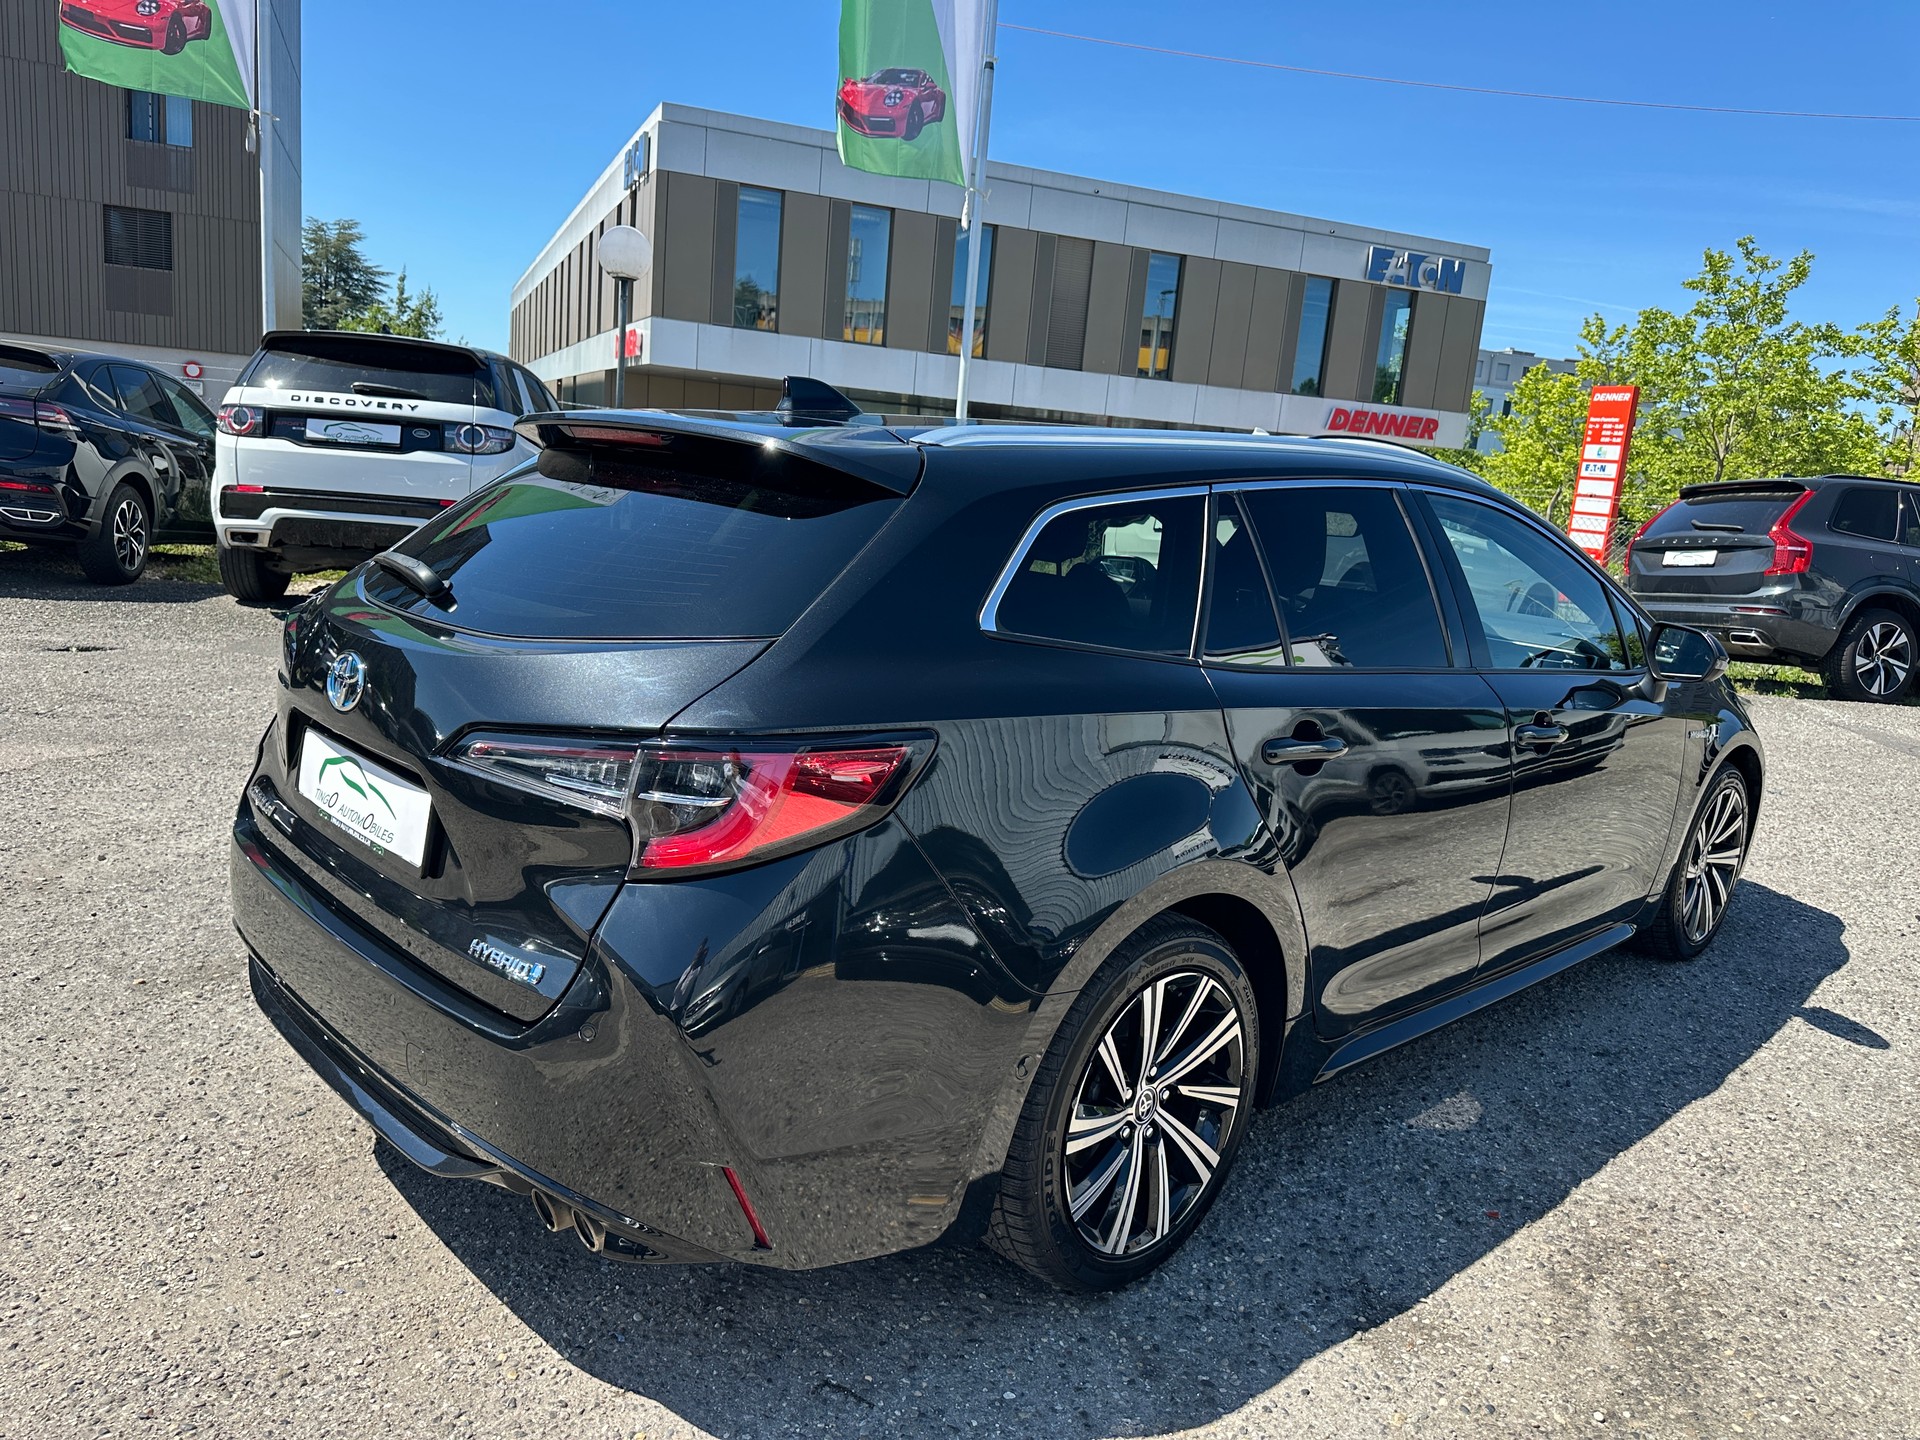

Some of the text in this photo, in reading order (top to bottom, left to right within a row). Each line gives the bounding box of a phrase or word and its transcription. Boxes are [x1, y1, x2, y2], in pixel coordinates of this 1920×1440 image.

[1366, 246, 1466, 295] EATON
[291, 394, 419, 411] DISCOVERY
[1593, 393, 1631, 402] DENNER
[1327, 407, 1439, 440] DENNER
[314, 788, 339, 809] TINGO
[337, 803, 394, 844] AUTOMOBILES
[468, 938, 534, 981] HYBRID
